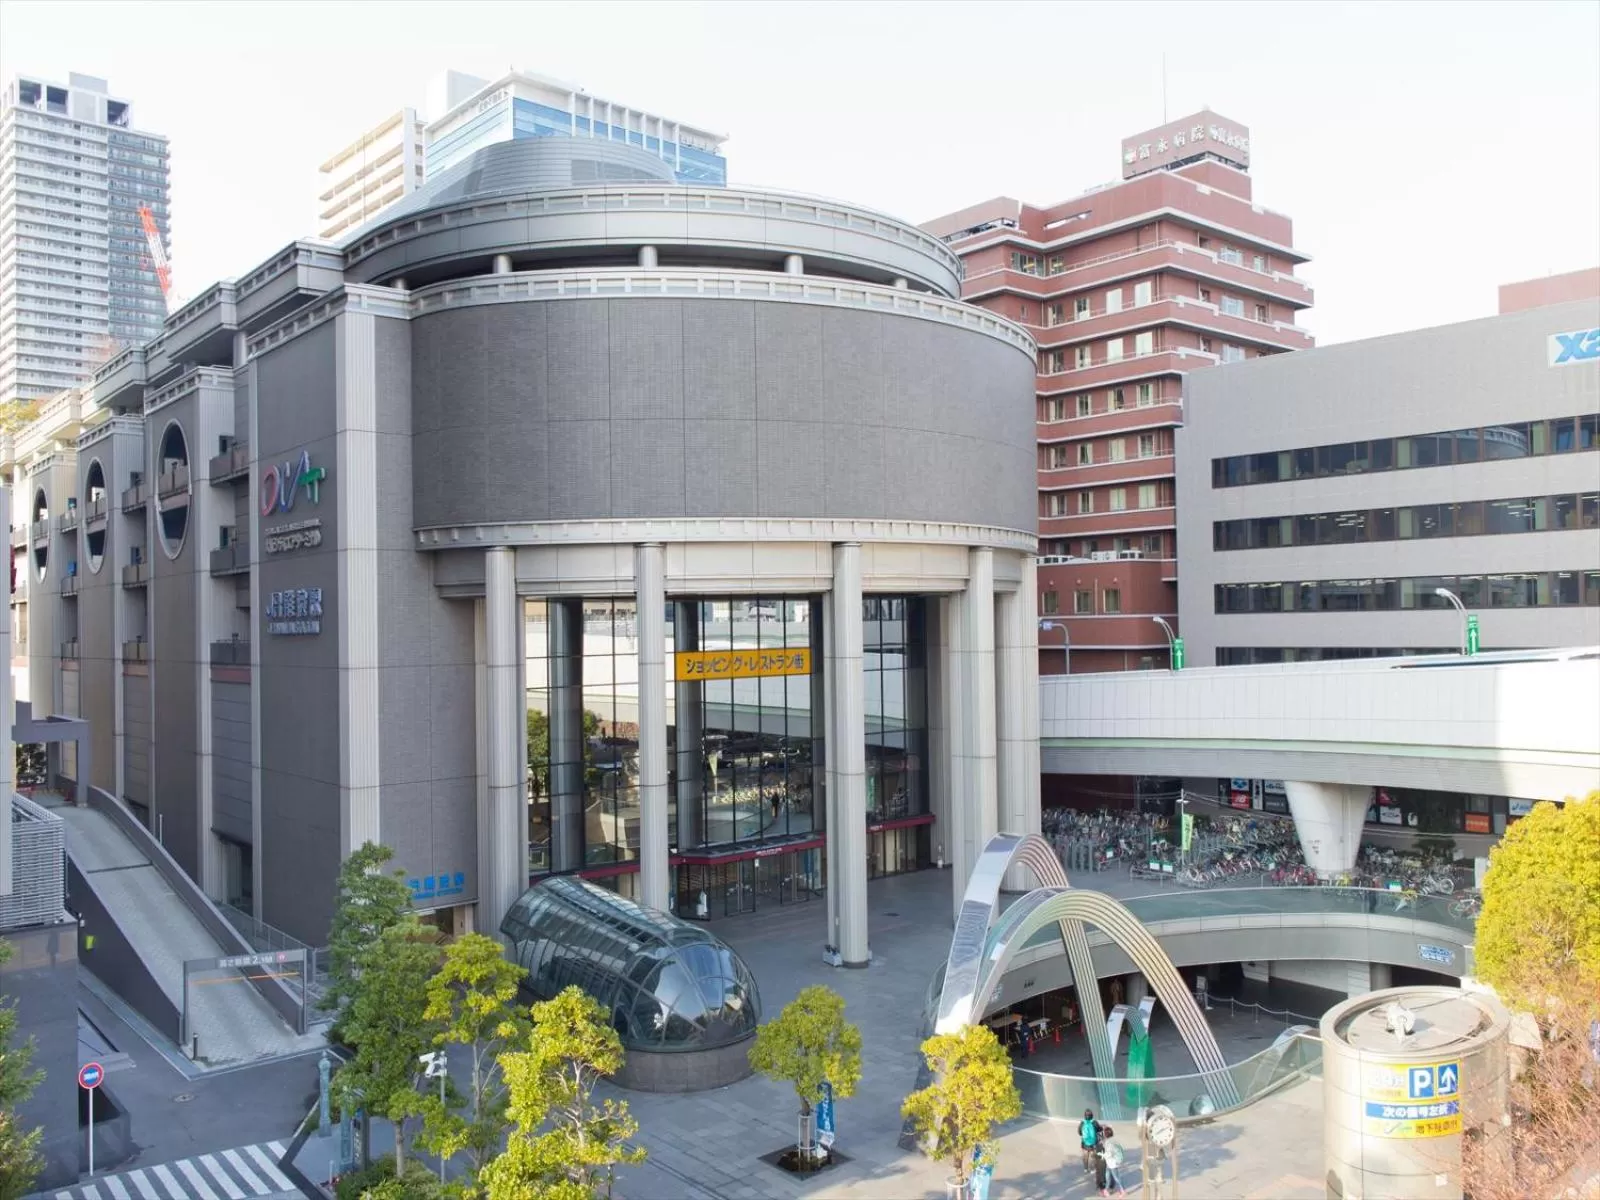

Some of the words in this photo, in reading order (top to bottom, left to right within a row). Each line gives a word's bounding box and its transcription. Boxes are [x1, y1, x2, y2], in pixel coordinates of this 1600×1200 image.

[686, 653, 804, 674] ショッピング・レストラン街
[1413, 1069, 1432, 1098] P
